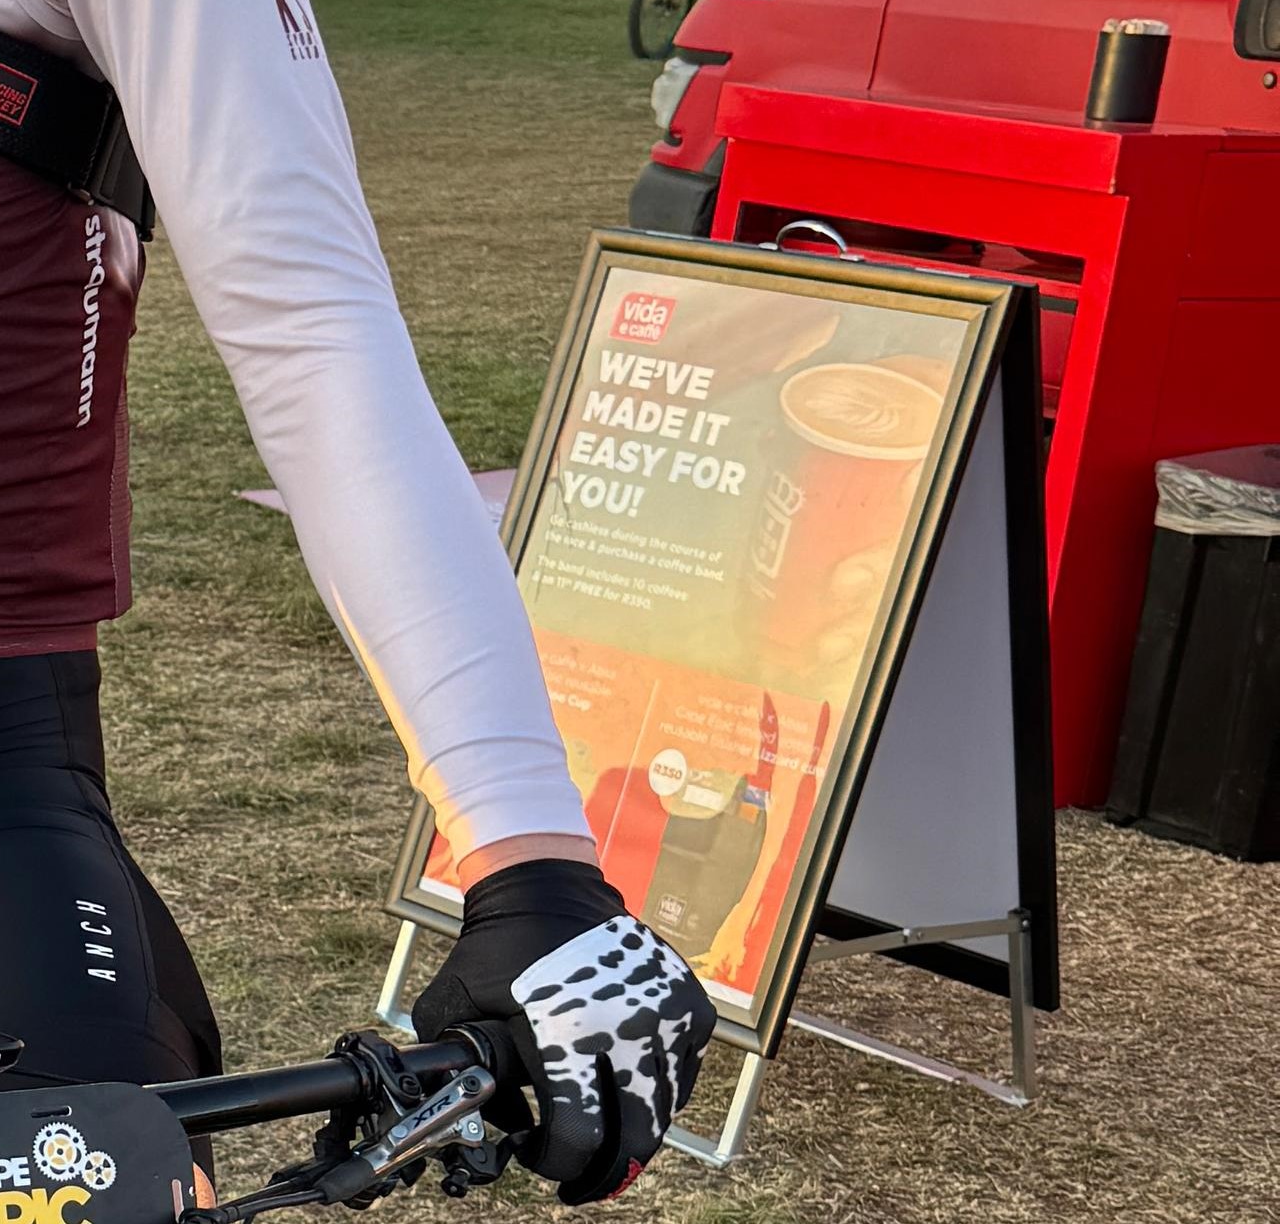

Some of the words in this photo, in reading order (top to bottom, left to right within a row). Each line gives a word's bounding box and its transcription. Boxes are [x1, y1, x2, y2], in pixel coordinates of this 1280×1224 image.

[76, 214, 107, 428] straumann
[623, 297, 669, 326] vida
[599, 350, 715, 401] WE'VE
[582, 390, 688, 439] MADE
[689, 411, 731, 447] IT
[570, 431, 667, 478] EASY
[668, 451, 746, 497] FOR
[563, 471, 646, 518] YOU!
[597, 544, 646, 563] purchase
[657, 558, 693, 574] coffee
[611, 528, 647, 548] during
[649, 536, 668, 551] the
[669, 543, 706, 560] course
[708, 550, 723, 564] of
[538, 555, 557, 570] The
[557, 560, 585, 576] band
[632, 577, 646, 590] 10
[413, 1094, 452, 1129] XTR
